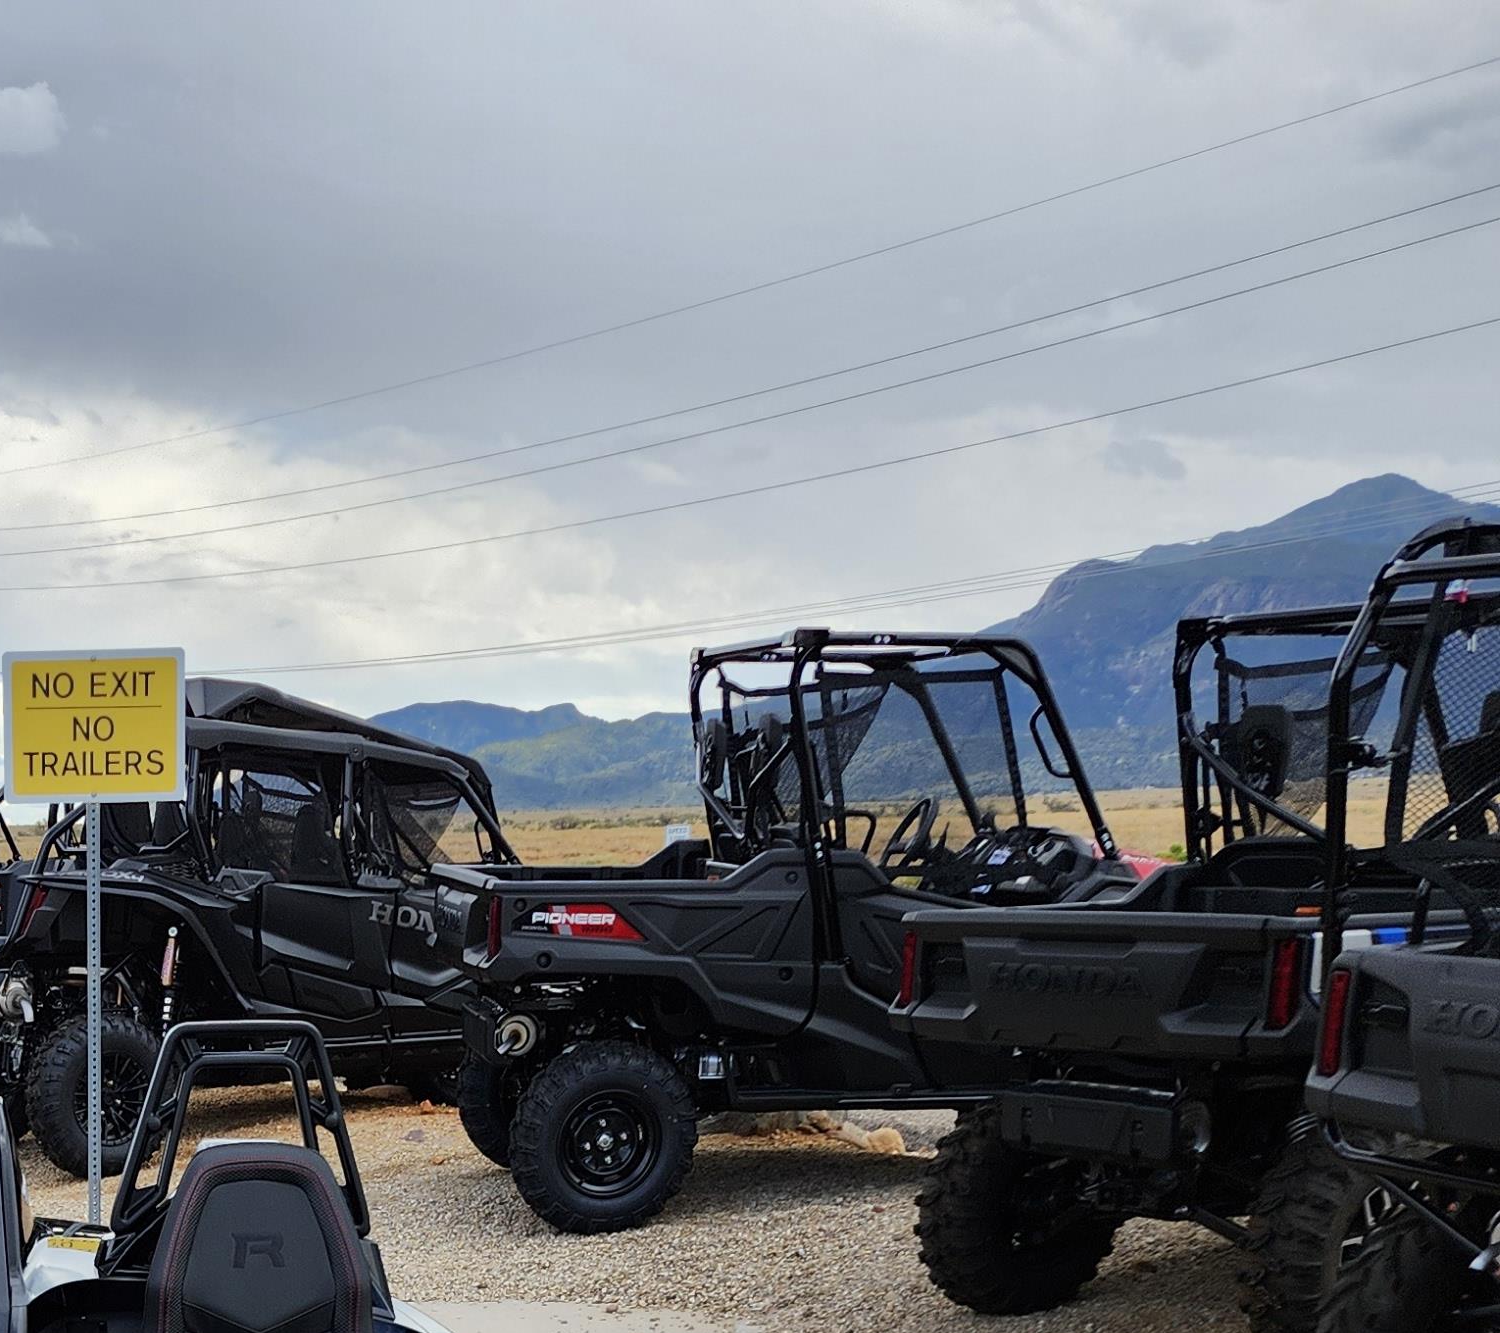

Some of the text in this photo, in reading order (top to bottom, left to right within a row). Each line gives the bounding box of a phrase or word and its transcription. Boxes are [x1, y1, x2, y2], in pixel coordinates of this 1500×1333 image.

[31, 671, 156, 699] NO EXIT
[72, 715, 115, 741] NO
[23, 749, 165, 777] TRAILERS
[368, 900, 437, 933] HON
[531, 911, 616, 925] PIONEER
[231, 1232, 286, 1269] R
